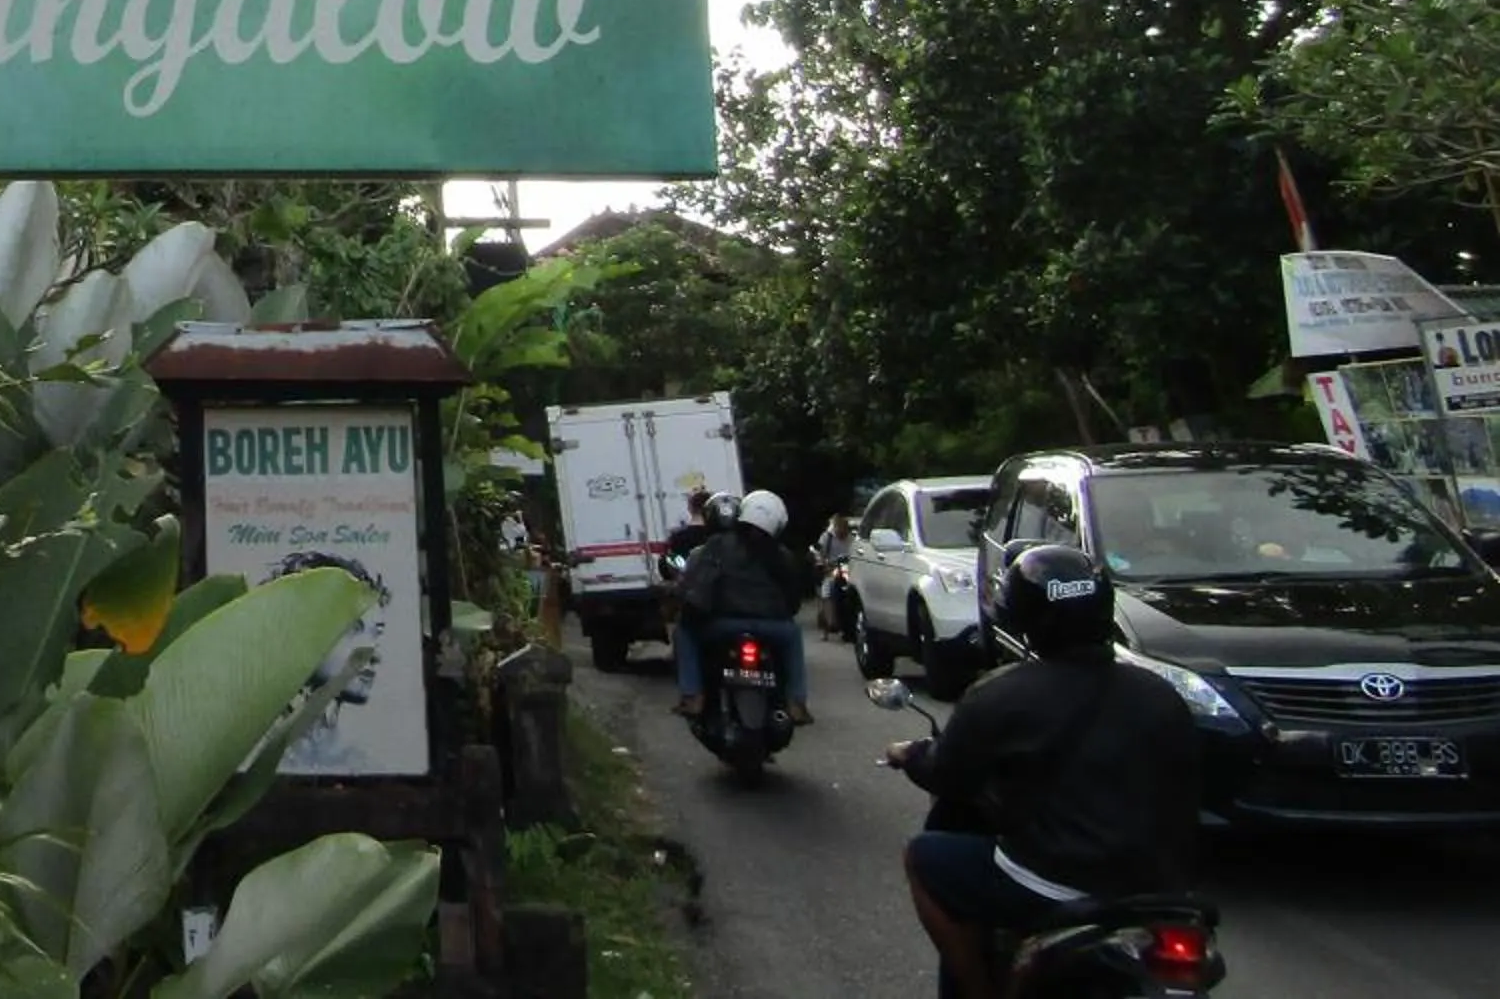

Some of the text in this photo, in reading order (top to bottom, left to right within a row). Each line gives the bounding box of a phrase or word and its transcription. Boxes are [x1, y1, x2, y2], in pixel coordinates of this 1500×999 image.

[207, 425, 410, 476] BOREH AYU
[228, 522, 392, 550] Mini Spa Salon
[1341, 741, 1368, 764] DK
